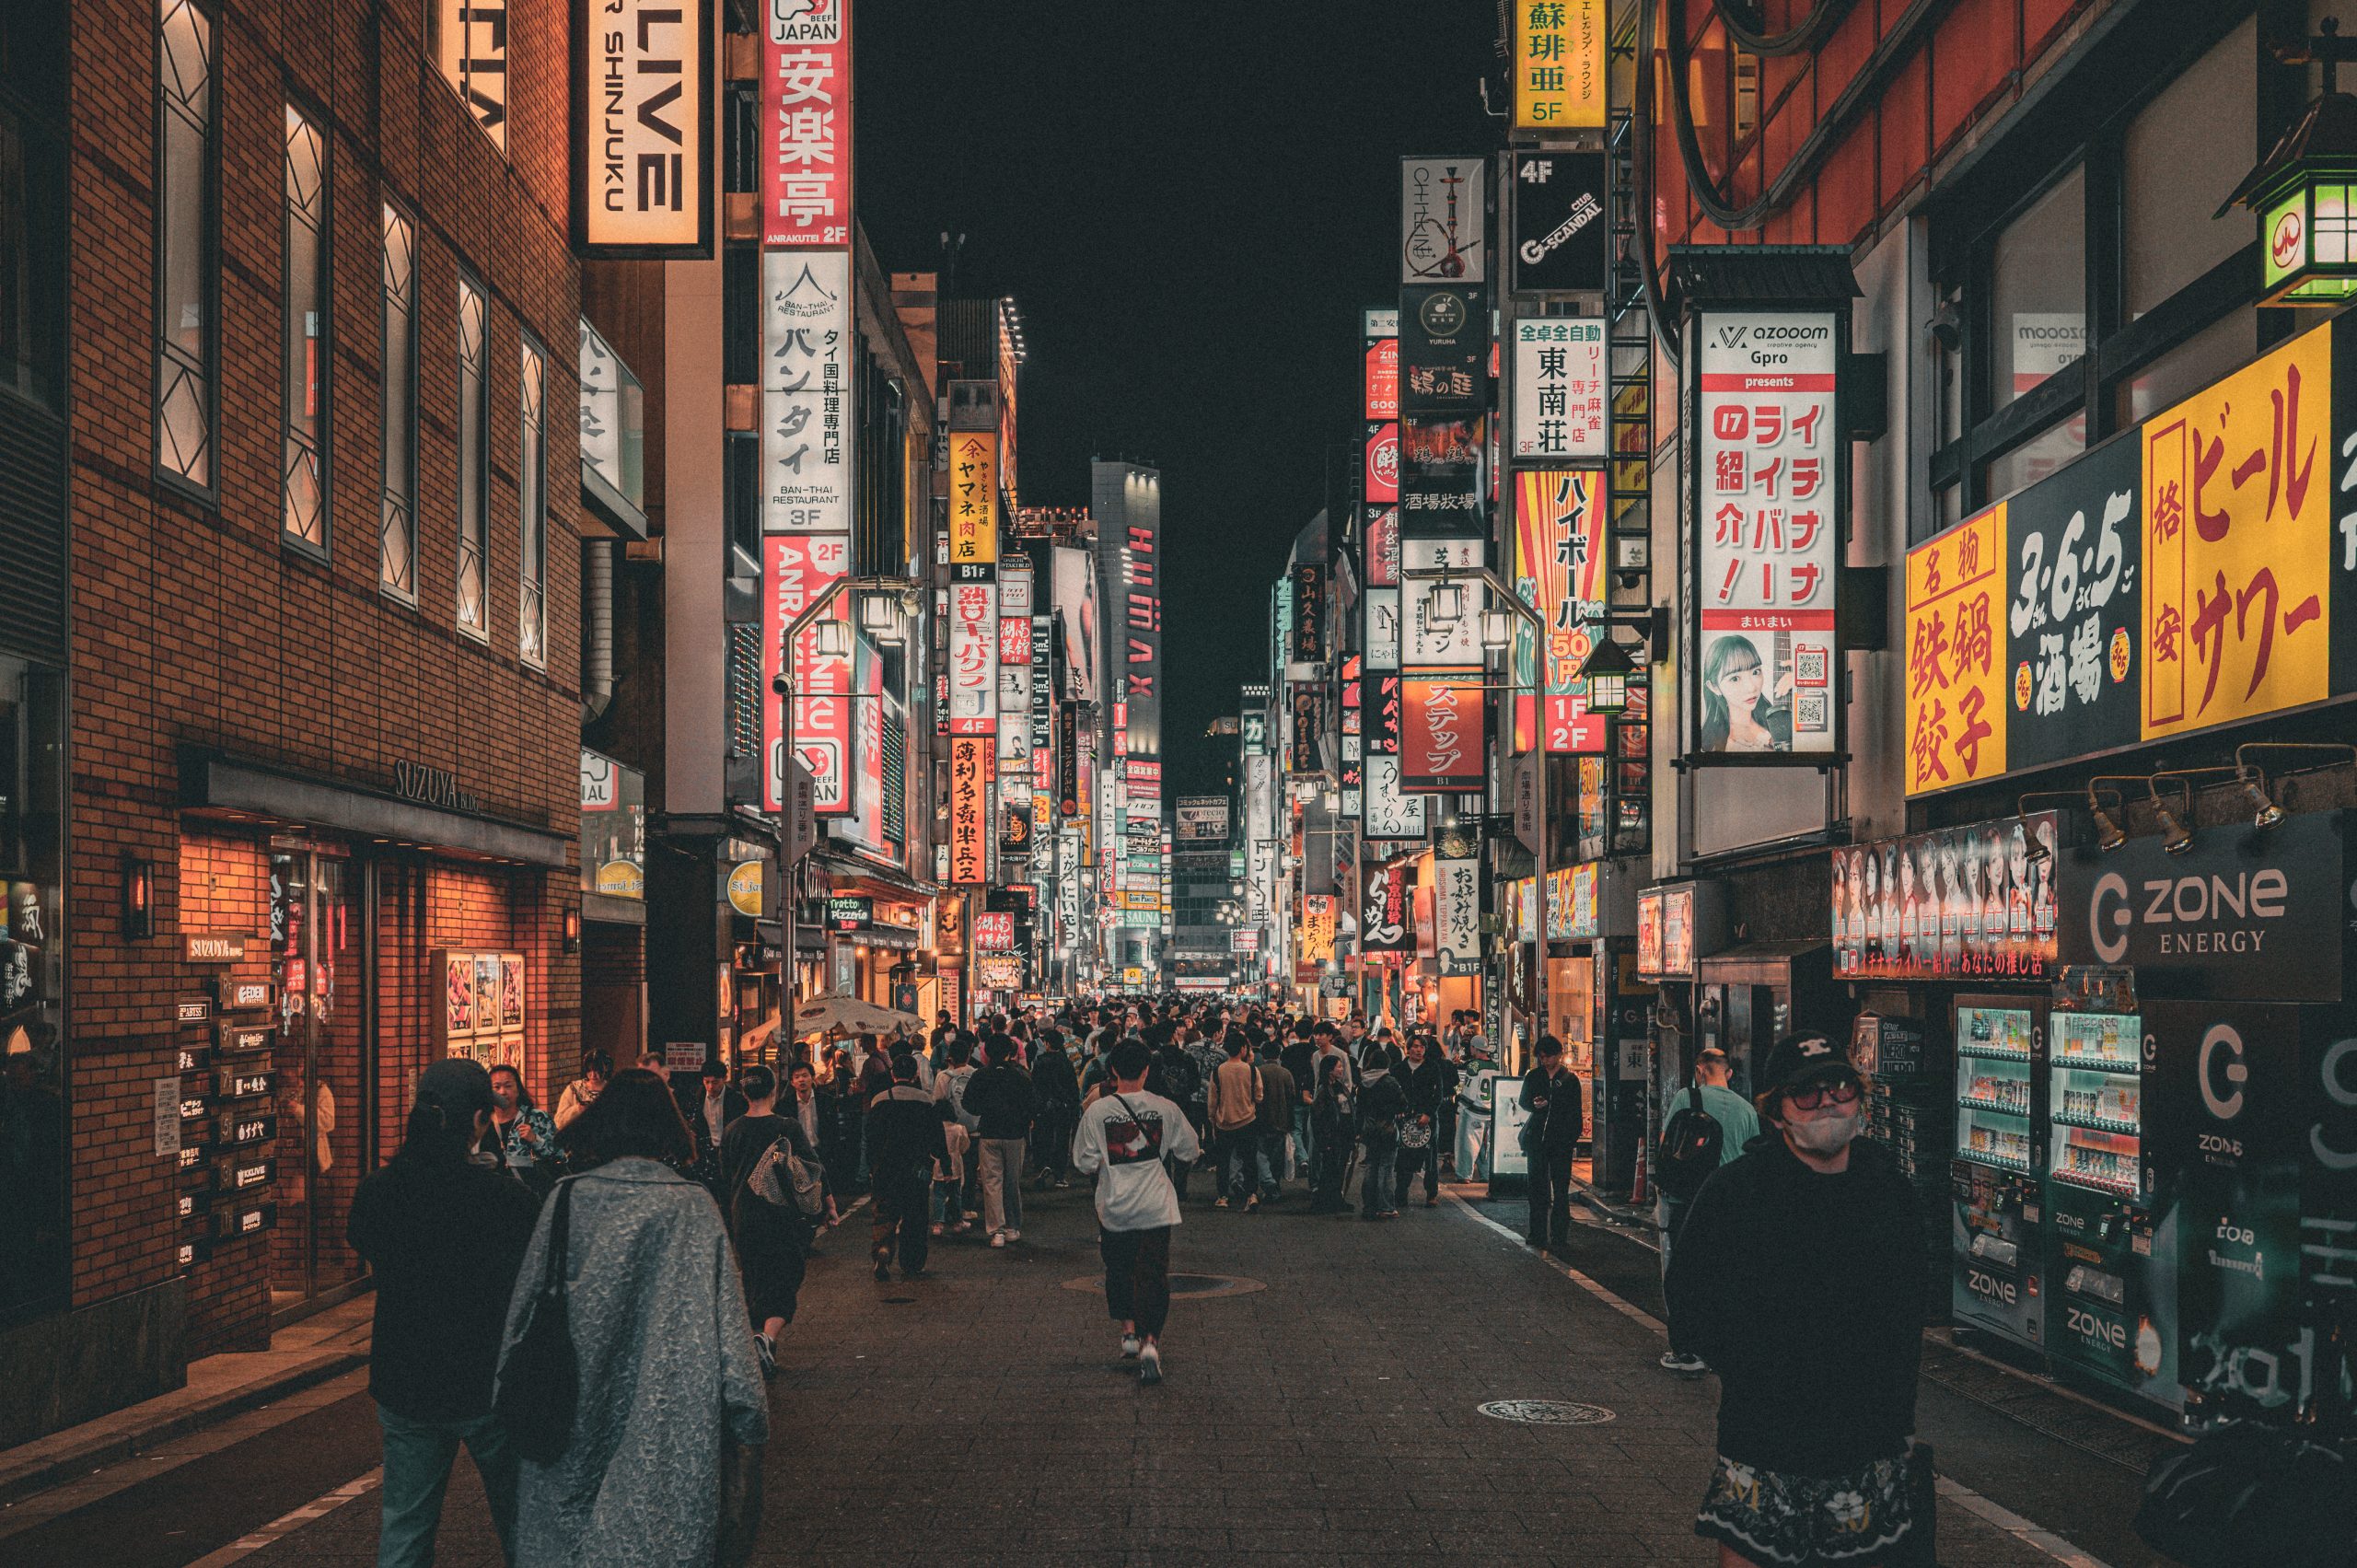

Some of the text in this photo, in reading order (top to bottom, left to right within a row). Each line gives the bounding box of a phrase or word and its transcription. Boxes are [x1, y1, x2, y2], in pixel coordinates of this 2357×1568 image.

[775, 23, 837, 41] JAPAN
[637, 0, 682, 212] LIVE
[1532, 102, 1562, 121] 5F
[605, 30, 623, 212] SHINJUKU
[779, 49, 835, 226] 安楽亭
[1520, 160, 1552, 183] 4F
[1571, 192, 1593, 213] CLUB
[766, 226, 847, 243] ANRAKUTEI 2F
[1520, 325, 1601, 343] 全卓全自動
[1753, 327, 1829, 340] azooom
[1751, 351, 1788, 367] Gpro
[1587, 346, 1602, 431] リーチ麻雀
[1745, 377, 1794, 389] presents
[773, 329, 817, 476] バンタイ
[823, 329, 841, 465] タイ国料理専門店
[1537, 346, 1568, 453] 東南荘
[1572, 380, 1585, 444] 専門店
[1368, 424, 1379, 434] 4F
[1519, 441, 1535, 453] 3F
[2192, 362, 2318, 542] ビール
[772, 496, 840, 505] RESTAURANT
[780, 485, 833, 494] BAN-THAI
[980, 461, 990, 528] やきとん酒場
[957, 462, 977, 559] ヤマネ肉店
[1368, 508, 1381, 518] 3F
[1405, 493, 1477, 510] 酒場牧場
[1753, 405, 1786, 602] ライバー
[1791, 404, 1824, 603] イチナナ
[790, 509, 822, 526] 3F
[818, 543, 843, 561] 2F
[1555, 476, 1589, 632] ハイボール
[1922, 527, 1980, 597] 名物
[961, 564, 986, 578] B1F
[2153, 480, 2183, 663] 格安
[1740, 616, 1792, 628] まいまい
[1551, 633, 1591, 659] 50
[1910, 591, 1992, 701] 鉄鍋
[2191, 566, 2321, 720] サワー
[1558, 658, 1583, 684] 円
[2036, 611, 2102, 716] 酒場
[961, 719, 985, 733] 4F
[1423, 683, 1462, 773] ステップ
[1552, 727, 1589, 749] 2F
[1910, 685, 1992, 791] 餃子
[396, 758, 458, 808] SUZUYA
[1436, 777, 1449, 785] B1
[1400, 798, 1422, 818] 屋
[731, 880, 762, 892] St.Ja
[1387, 868, 1402, 924] 東京豚骨
[1438, 868, 1447, 901] HIROSHIMA
[1126, 911, 1160, 923] SAUNA
[1450, 866, 1478, 949] お好み焼き
[191, 938, 229, 957] SUZUYA
[2160, 929, 2266, 955] ENERGY
[1458, 962, 1480, 973] B1F
[1980, 1294, 2005, 1309] ENERGY
[2080, 1335, 2112, 1354] ENERGY
